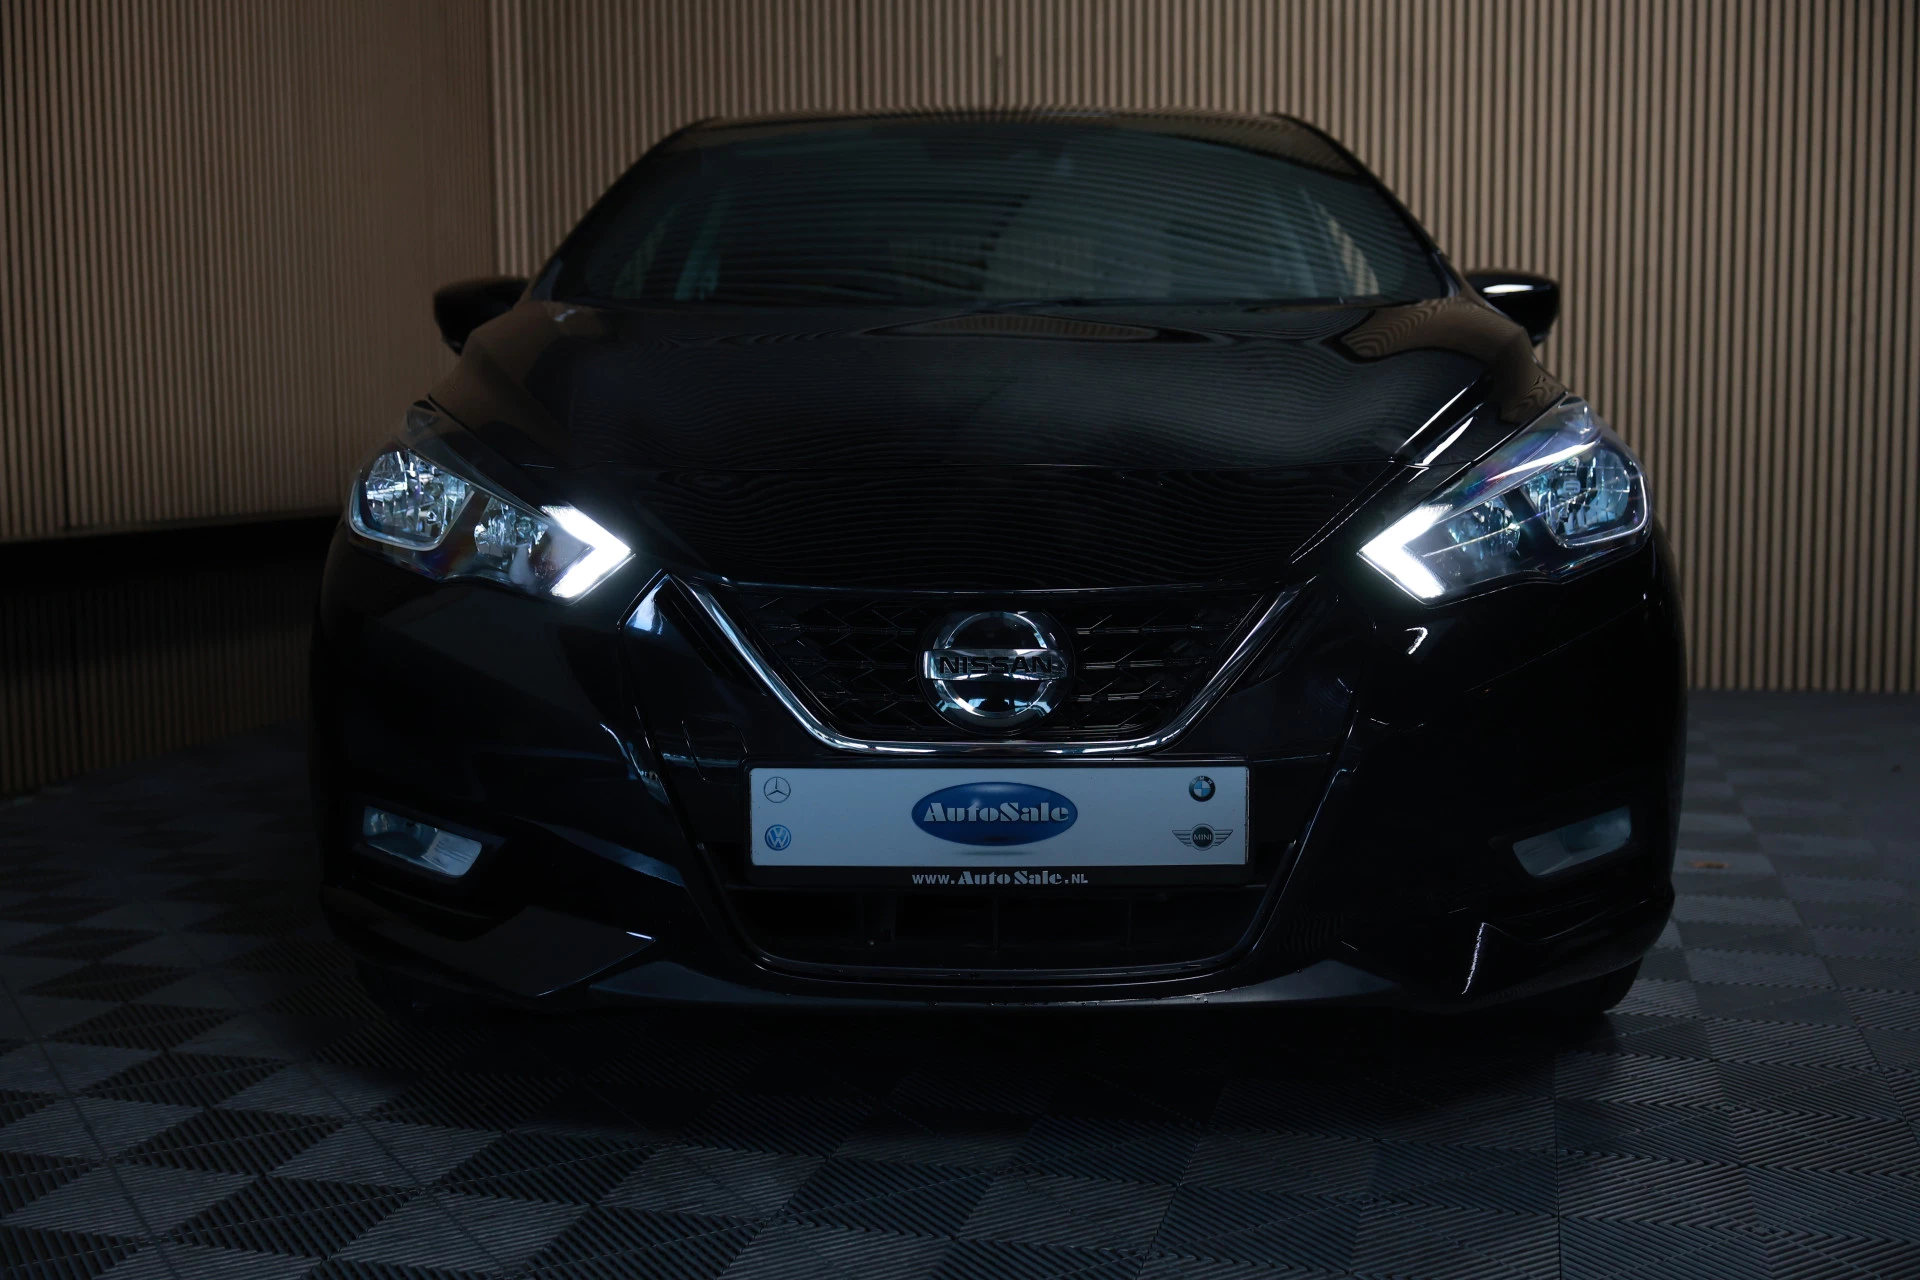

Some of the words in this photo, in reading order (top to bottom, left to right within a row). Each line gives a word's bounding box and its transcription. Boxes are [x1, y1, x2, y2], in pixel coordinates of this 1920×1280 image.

[939, 656, 1053, 674] NISSAN
[923, 802, 1070, 822] AutoSale
[1193, 833, 1213, 841] MINI
